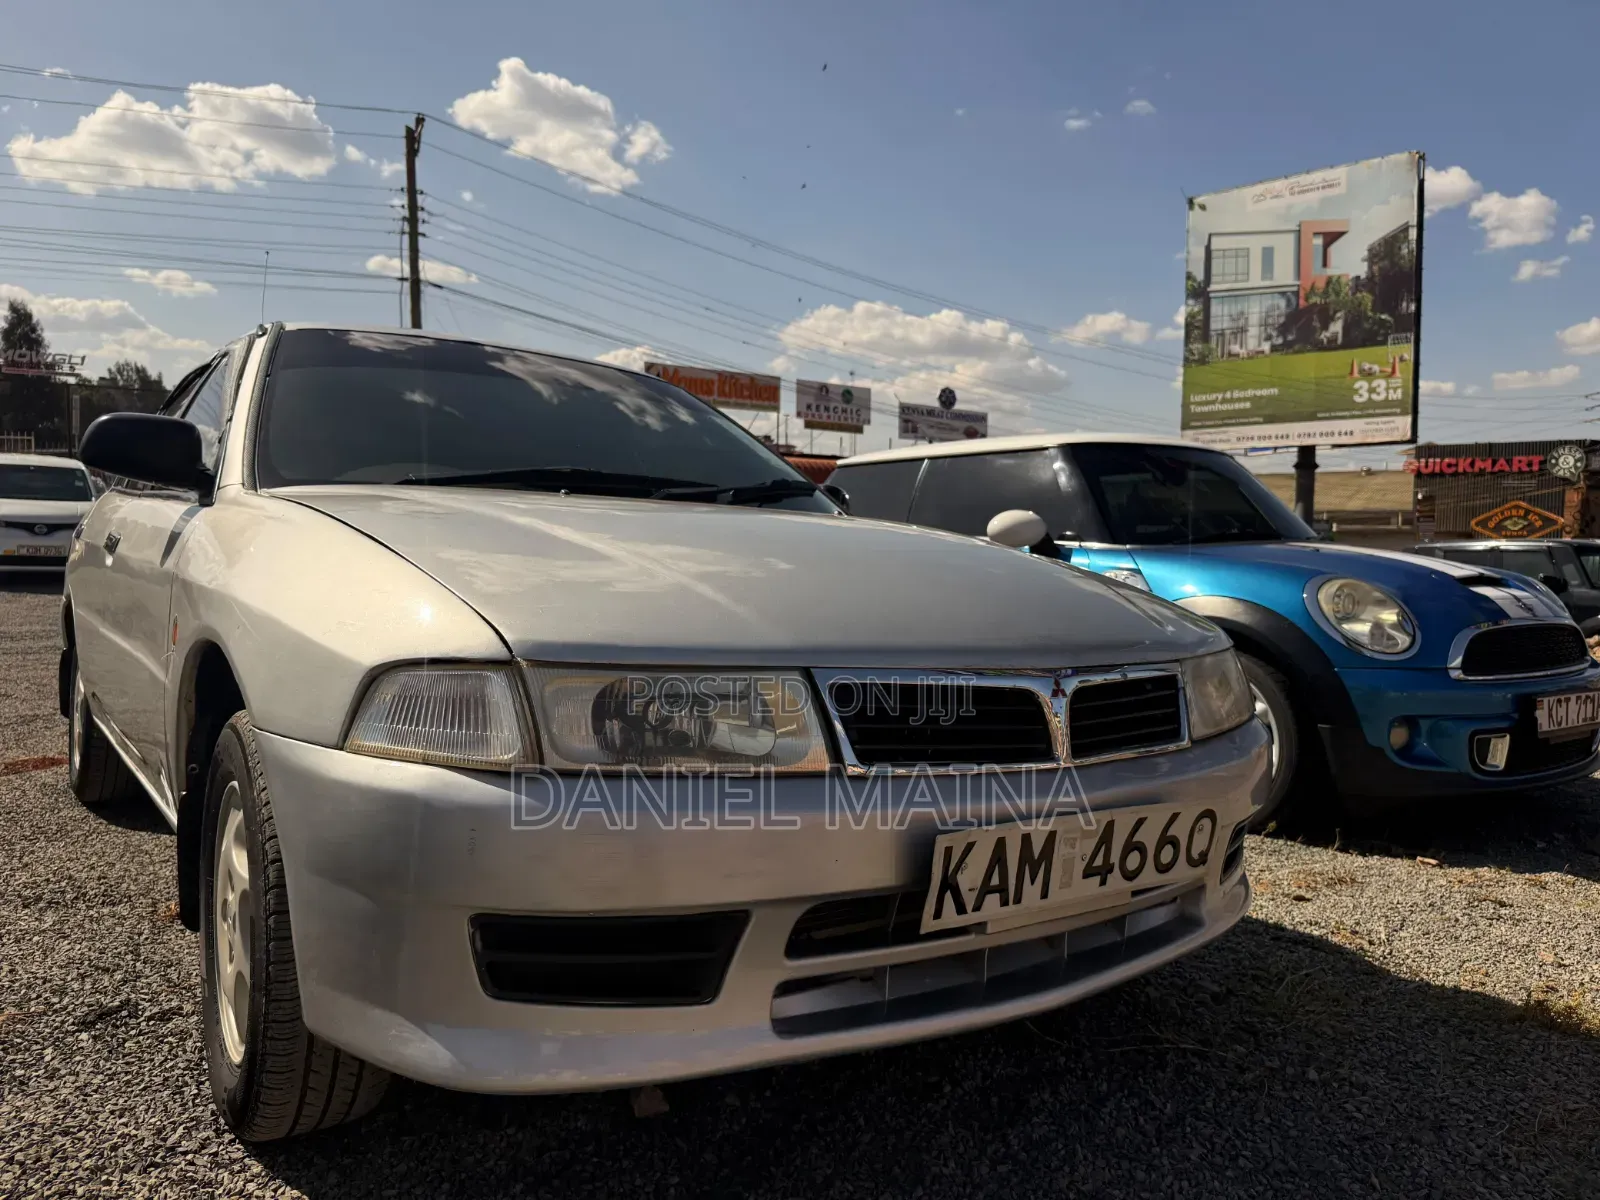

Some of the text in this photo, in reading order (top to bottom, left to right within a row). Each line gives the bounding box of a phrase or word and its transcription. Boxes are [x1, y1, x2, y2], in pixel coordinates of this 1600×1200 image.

[1190, 387, 1279, 402] Luxury 4 Bedroom
[806, 403, 861, 417] KENCHIC
[1190, 401, 1251, 413] Townhouses
[1552, 445, 1582, 459] FRESH
[1402, 455, 1544, 476] QUICKMART
[1553, 466, 1576, 477] EASY
[1487, 508, 1526, 529] GOLDEN
[1547, 696, 1571, 729] KCT
[932, 808, 1218, 921] KAM 466Q
